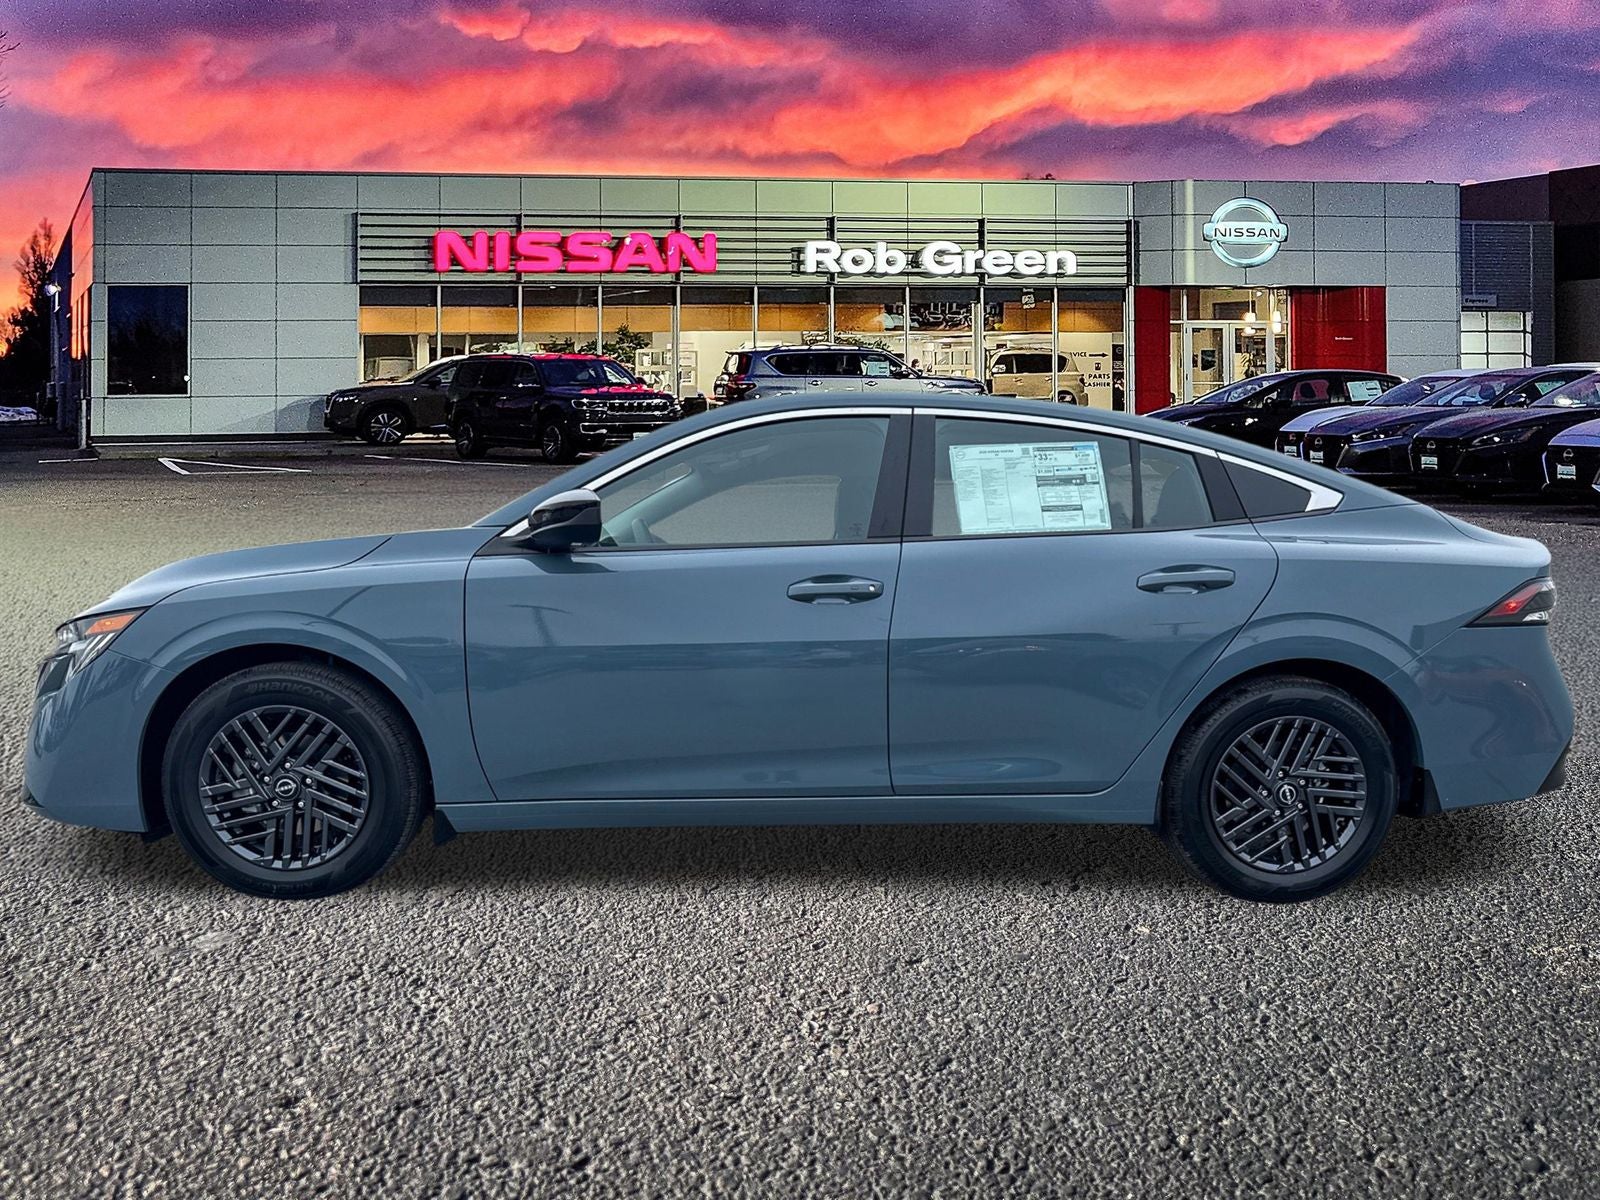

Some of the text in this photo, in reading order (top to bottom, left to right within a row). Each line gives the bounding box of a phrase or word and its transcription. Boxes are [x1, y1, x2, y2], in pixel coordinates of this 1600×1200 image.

[1214, 227, 1280, 238] NISSAN
[434, 230, 718, 274] NISSAN
[805, 240, 1078, 275] Rob Green
